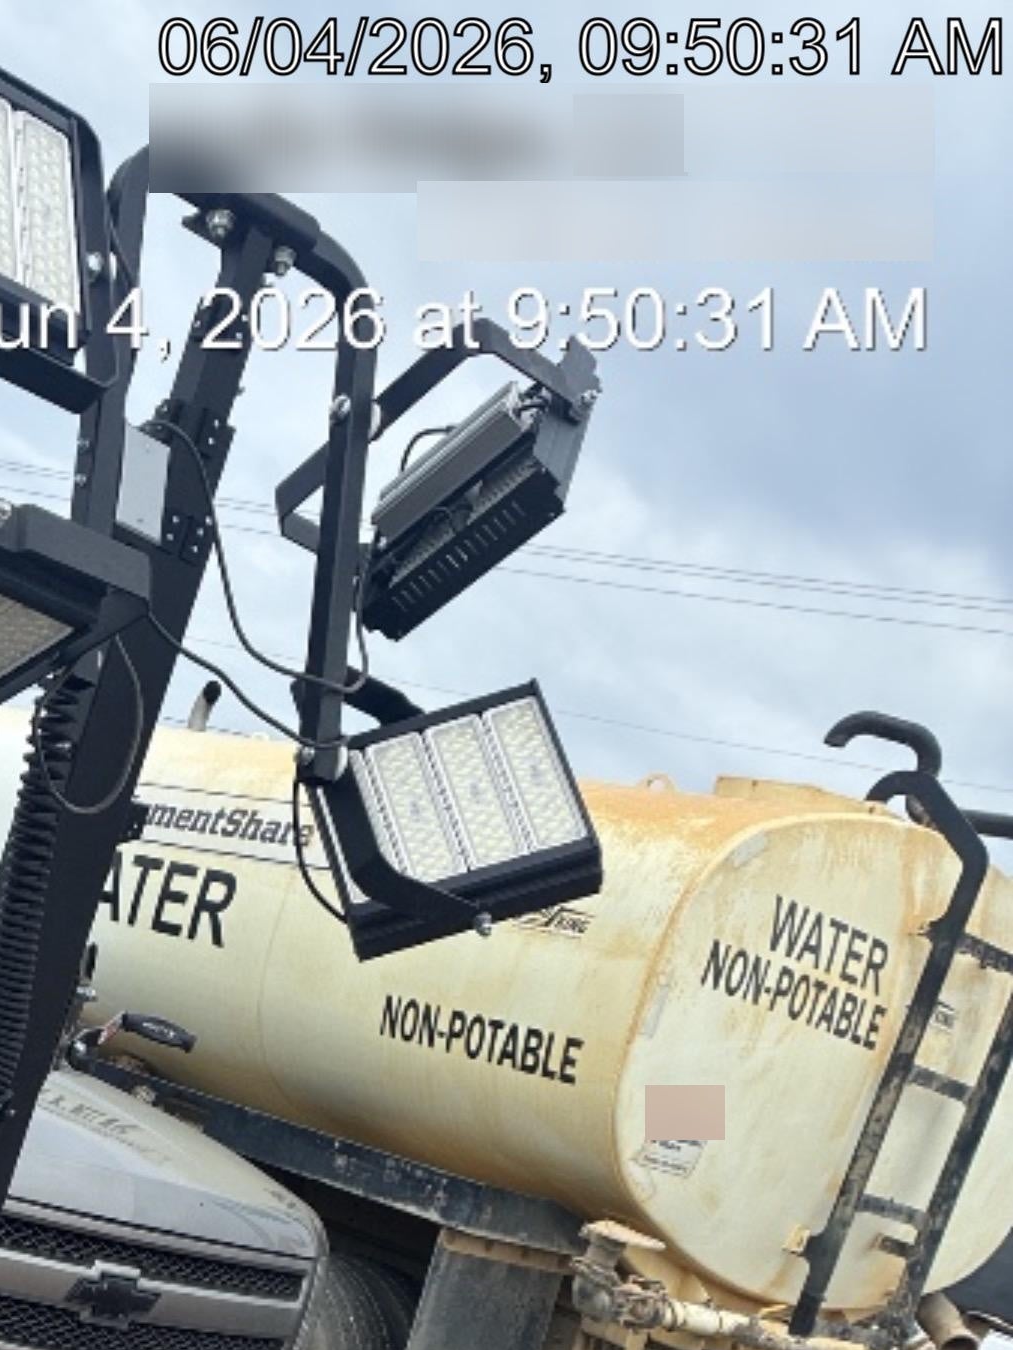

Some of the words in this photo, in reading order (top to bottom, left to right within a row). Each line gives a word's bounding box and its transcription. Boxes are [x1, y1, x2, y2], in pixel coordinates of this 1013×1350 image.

[146, 803, 315, 847] mentShare
[98, 852, 237, 948] ATER
[769, 894, 888, 996] WATER
[380, 994, 584, 1085] NON-POTABLE
[700, 939, 887, 1050] NON-POTABLE
